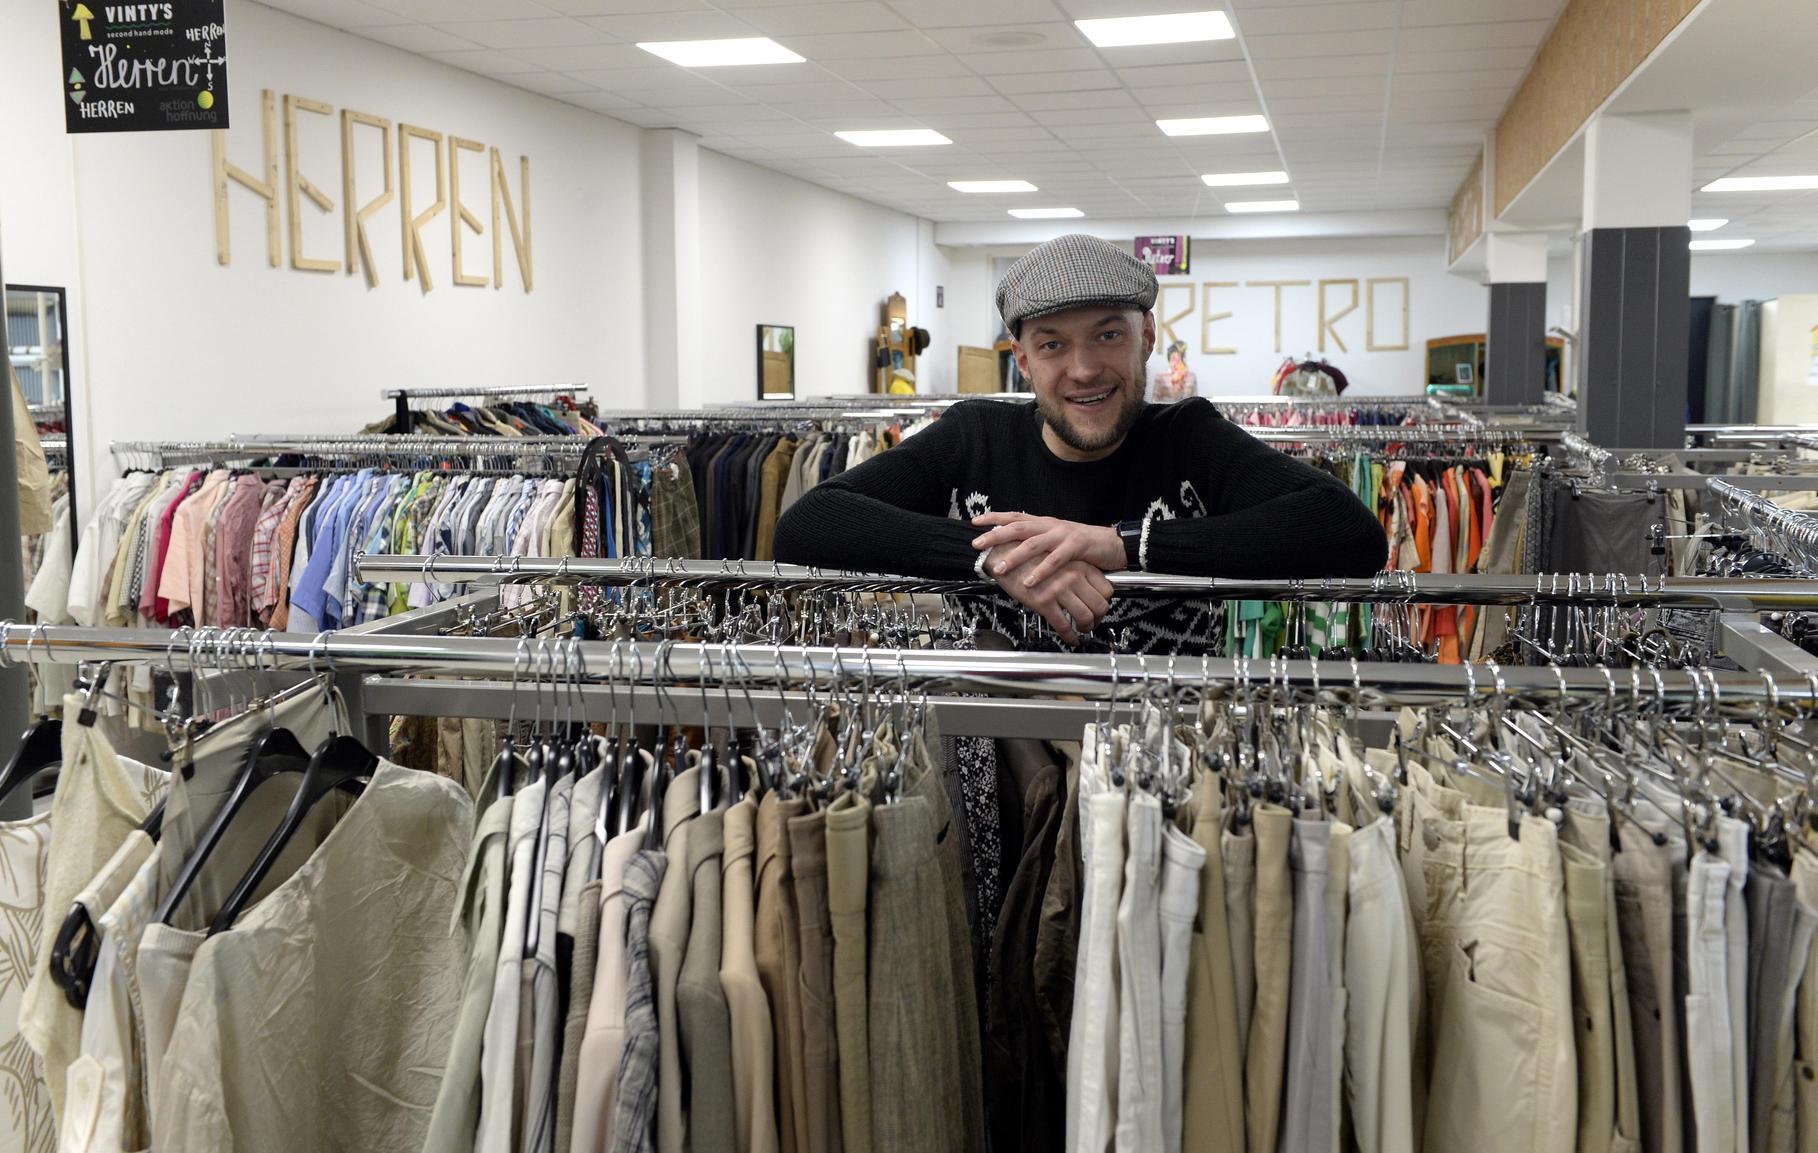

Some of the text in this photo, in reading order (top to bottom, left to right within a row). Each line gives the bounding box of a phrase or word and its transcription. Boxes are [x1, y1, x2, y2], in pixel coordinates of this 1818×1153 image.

[105, 3, 173, 23] VINTY'S
[107, 30, 133, 38] second
[134, 28, 152, 36] hand
[88, 43, 198, 88] Herren
[80, 100, 135, 118] HERREN
[160, 99, 195, 111] aktion
[166, 109, 217, 122] hoffnung
[211, 89, 533, 293] HERREN
[1156, 277, 1410, 354] RETRO
